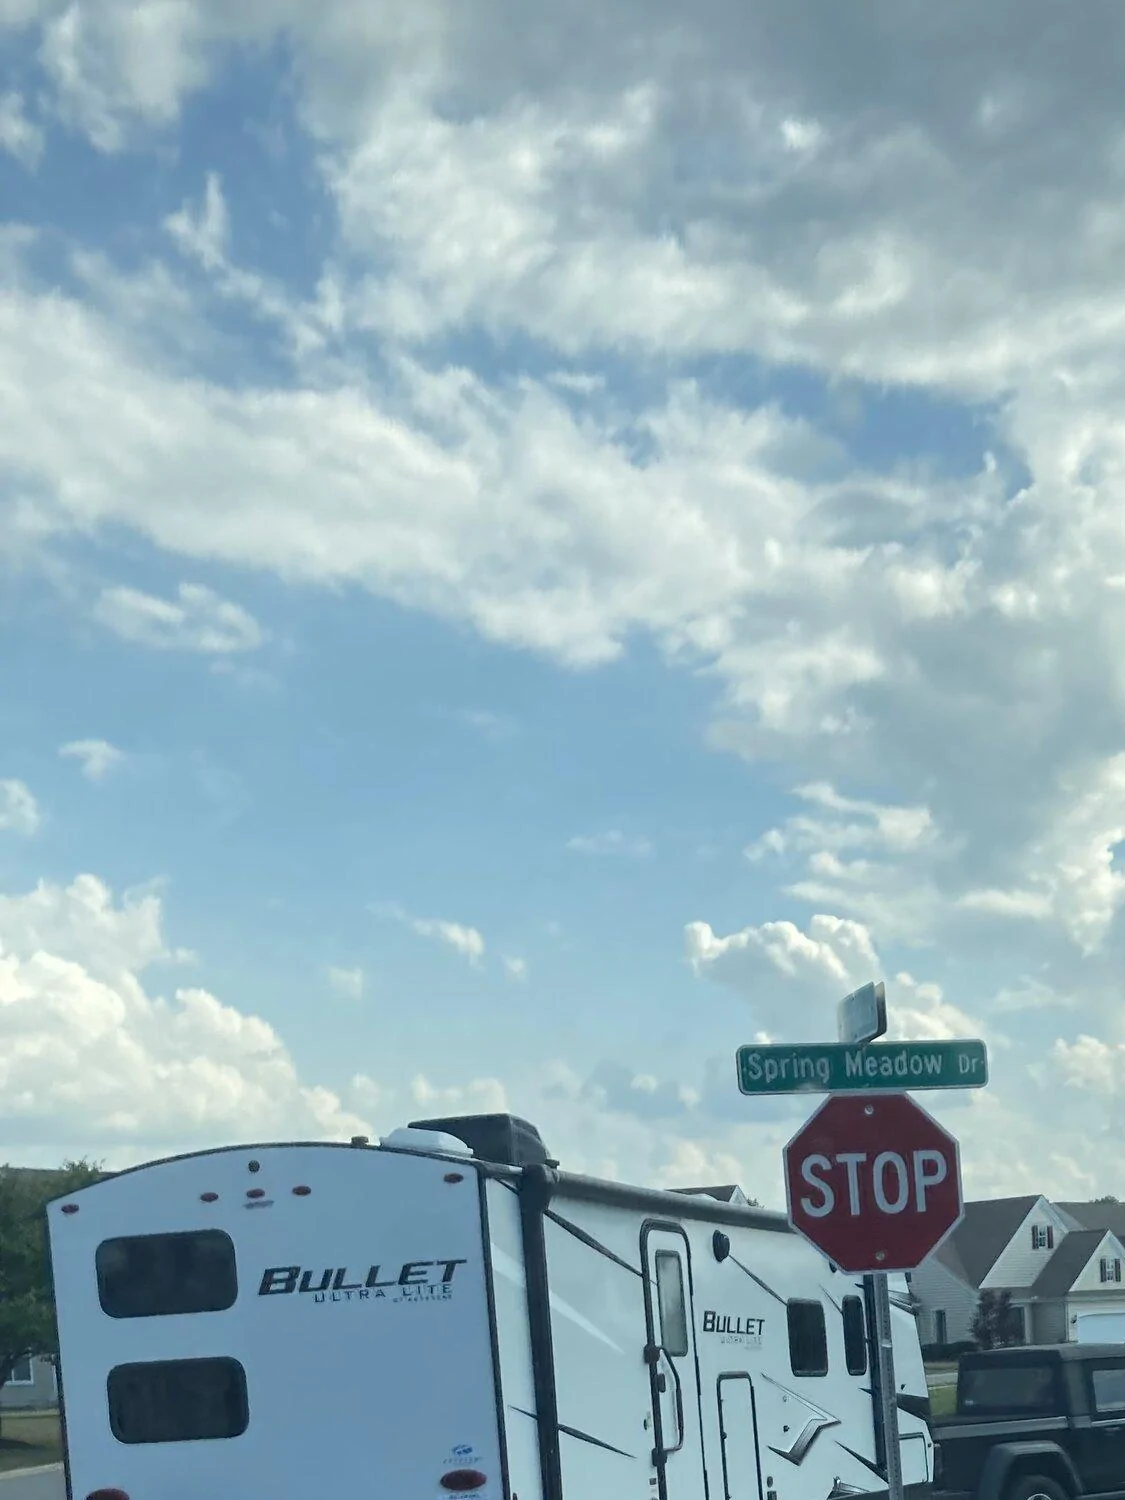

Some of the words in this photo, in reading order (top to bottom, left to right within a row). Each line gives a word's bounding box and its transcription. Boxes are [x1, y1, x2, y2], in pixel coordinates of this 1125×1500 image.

[749, 1053, 830, 1083] Spring
[845, 1050, 942, 1077] Meadow
[958, 1054, 979, 1074] Dr
[801, 1150, 947, 1218] STOP
[259, 1259, 467, 1295] BULLET
[314, 1288, 386, 1303] ULTRA
[402, 1283, 453, 1297] LITE
[703, 1310, 765, 1335] BULLET
